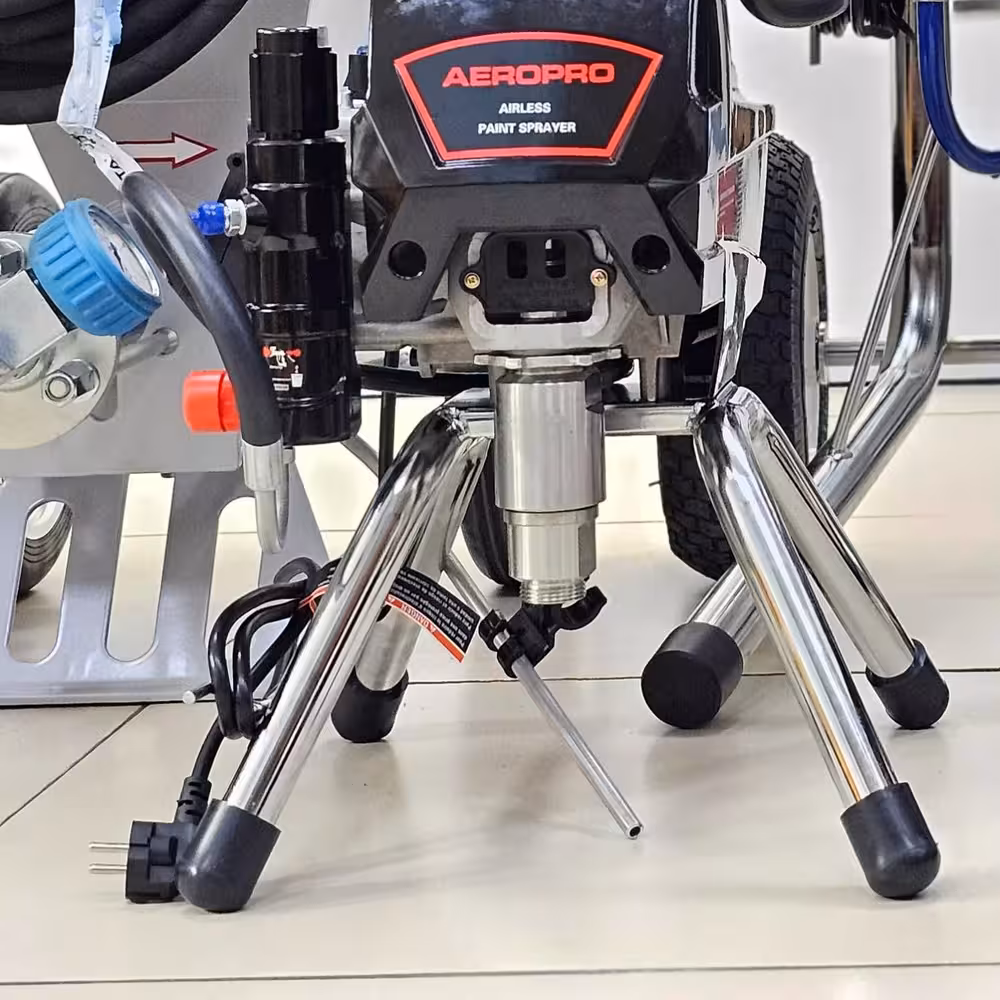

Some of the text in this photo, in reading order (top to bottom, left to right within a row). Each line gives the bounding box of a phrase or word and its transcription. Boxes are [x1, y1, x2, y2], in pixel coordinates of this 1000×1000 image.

[442, 63, 615, 88] AEROPRO
[498, 102, 551, 114] AIRLESS
[477, 122, 577, 134] PAINT SPRAYER
